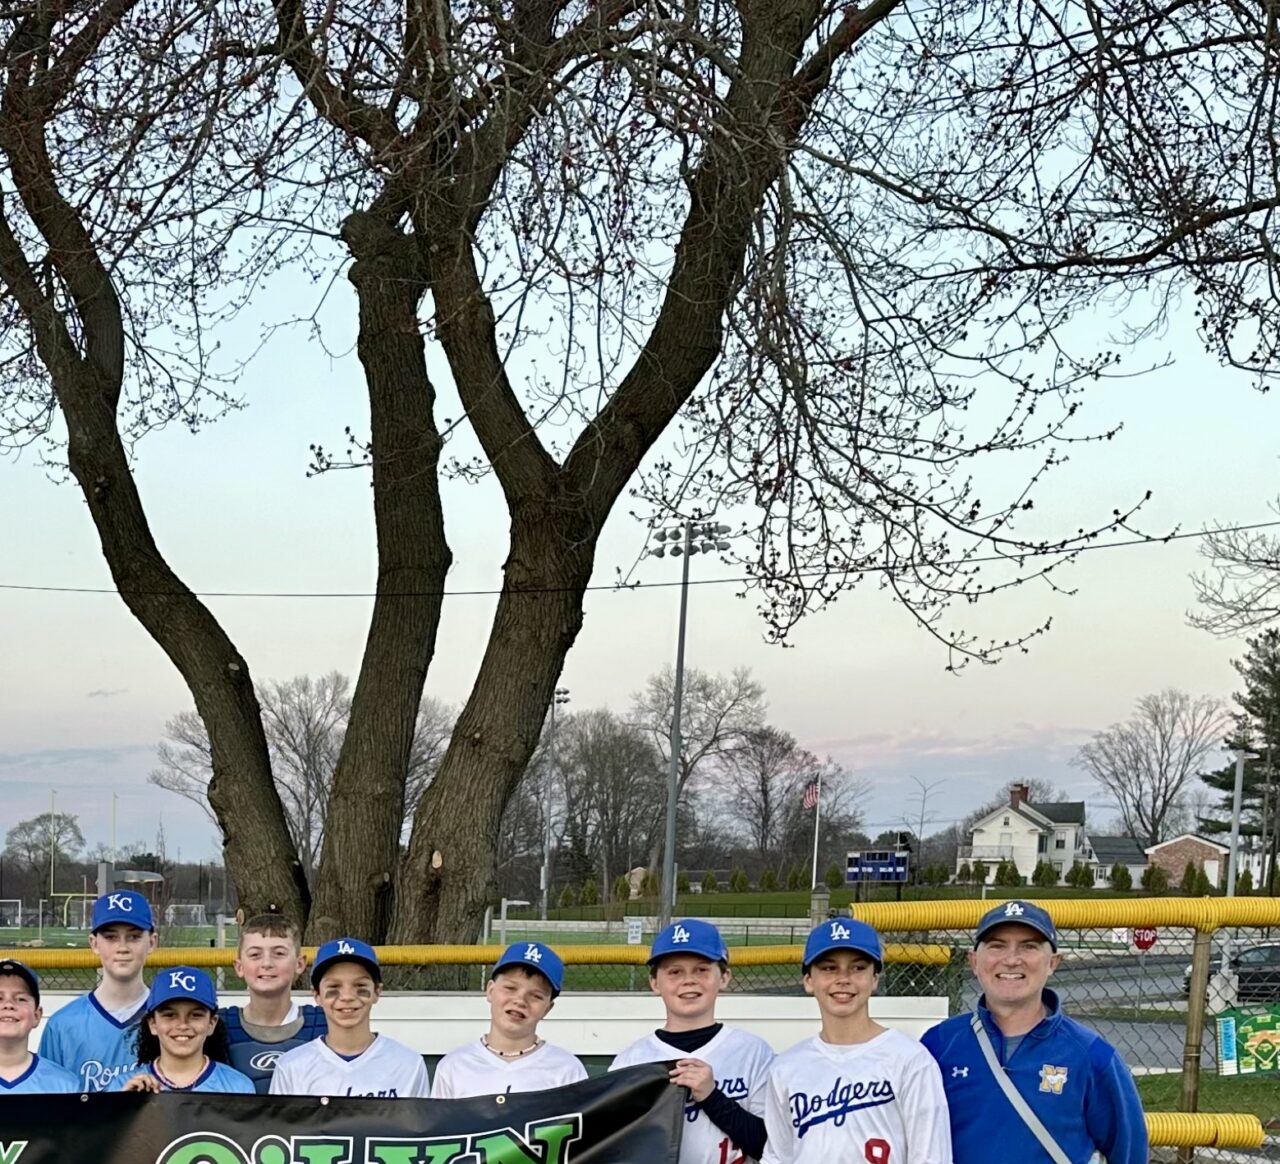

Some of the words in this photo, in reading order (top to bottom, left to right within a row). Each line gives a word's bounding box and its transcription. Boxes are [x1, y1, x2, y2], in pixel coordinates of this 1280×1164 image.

[107, 894, 133, 912] KC
[1004, 901, 1024, 917] LA
[671, 924, 690, 943] LA
[830, 921, 850, 941] LA
[1134, 929, 1156, 942] STOP
[337, 940, 355, 955] LA
[524, 943, 542, 963] LA
[169, 971, 196, 992] KC
[789, 1076, 895, 1139] Dodgers
